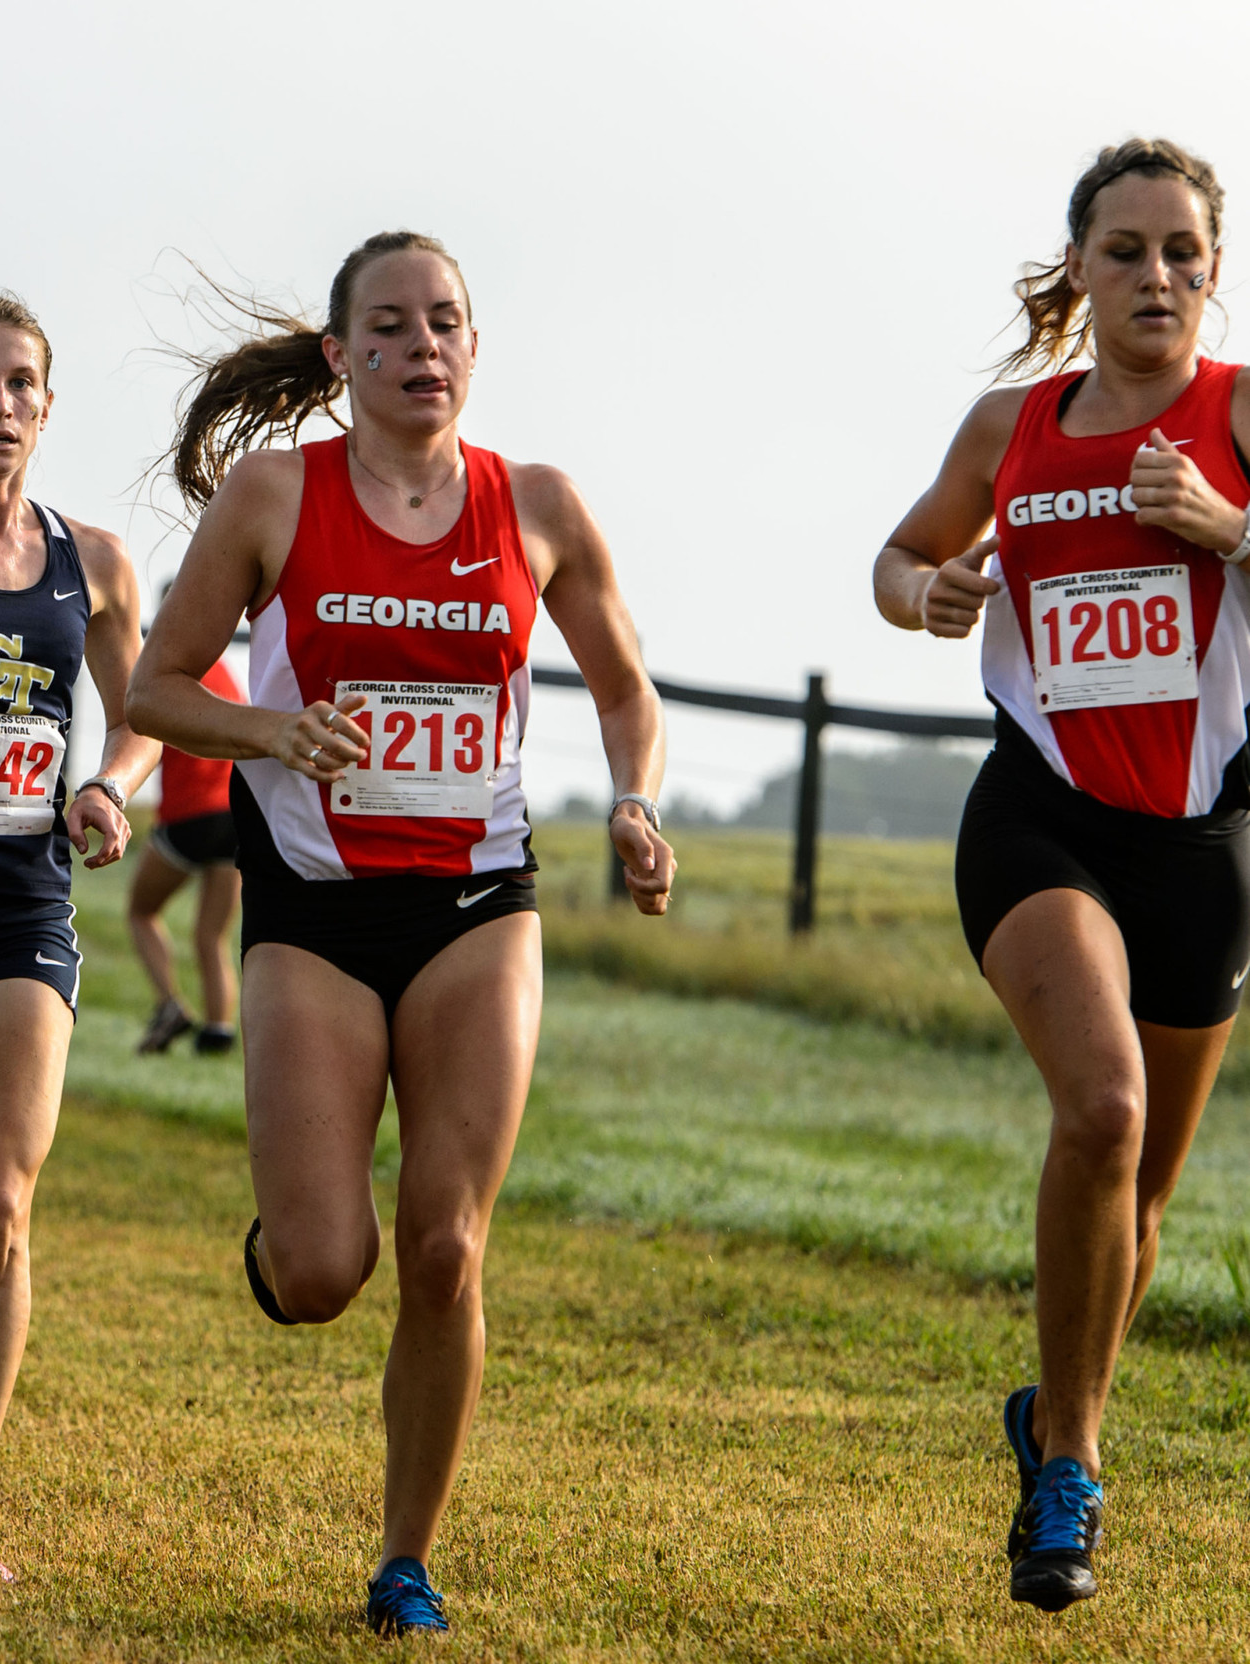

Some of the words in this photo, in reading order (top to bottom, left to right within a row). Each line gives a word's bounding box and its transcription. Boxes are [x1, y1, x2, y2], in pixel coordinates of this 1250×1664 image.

[1007, 484, 1140, 527] GEORG
[1039, 576, 1078, 591] GEORGIA
[1081, 571, 1118, 584] CROSS
[1121, 567, 1175, 580] COUNTRY
[1064, 582, 1142, 598] INVITATIONAL
[316, 592, 512, 634] GEORGIA
[1042, 595, 1180, 666] 1208
[348, 683, 396, 693] GEORGIA
[399, 684, 435, 694] CROSS
[437, 685, 486, 696] COUNTRY
[381, 695, 455, 706] INVITATIONAL
[15, 714, 48, 726] COUNT
[350, 711, 484, 774] 1213
